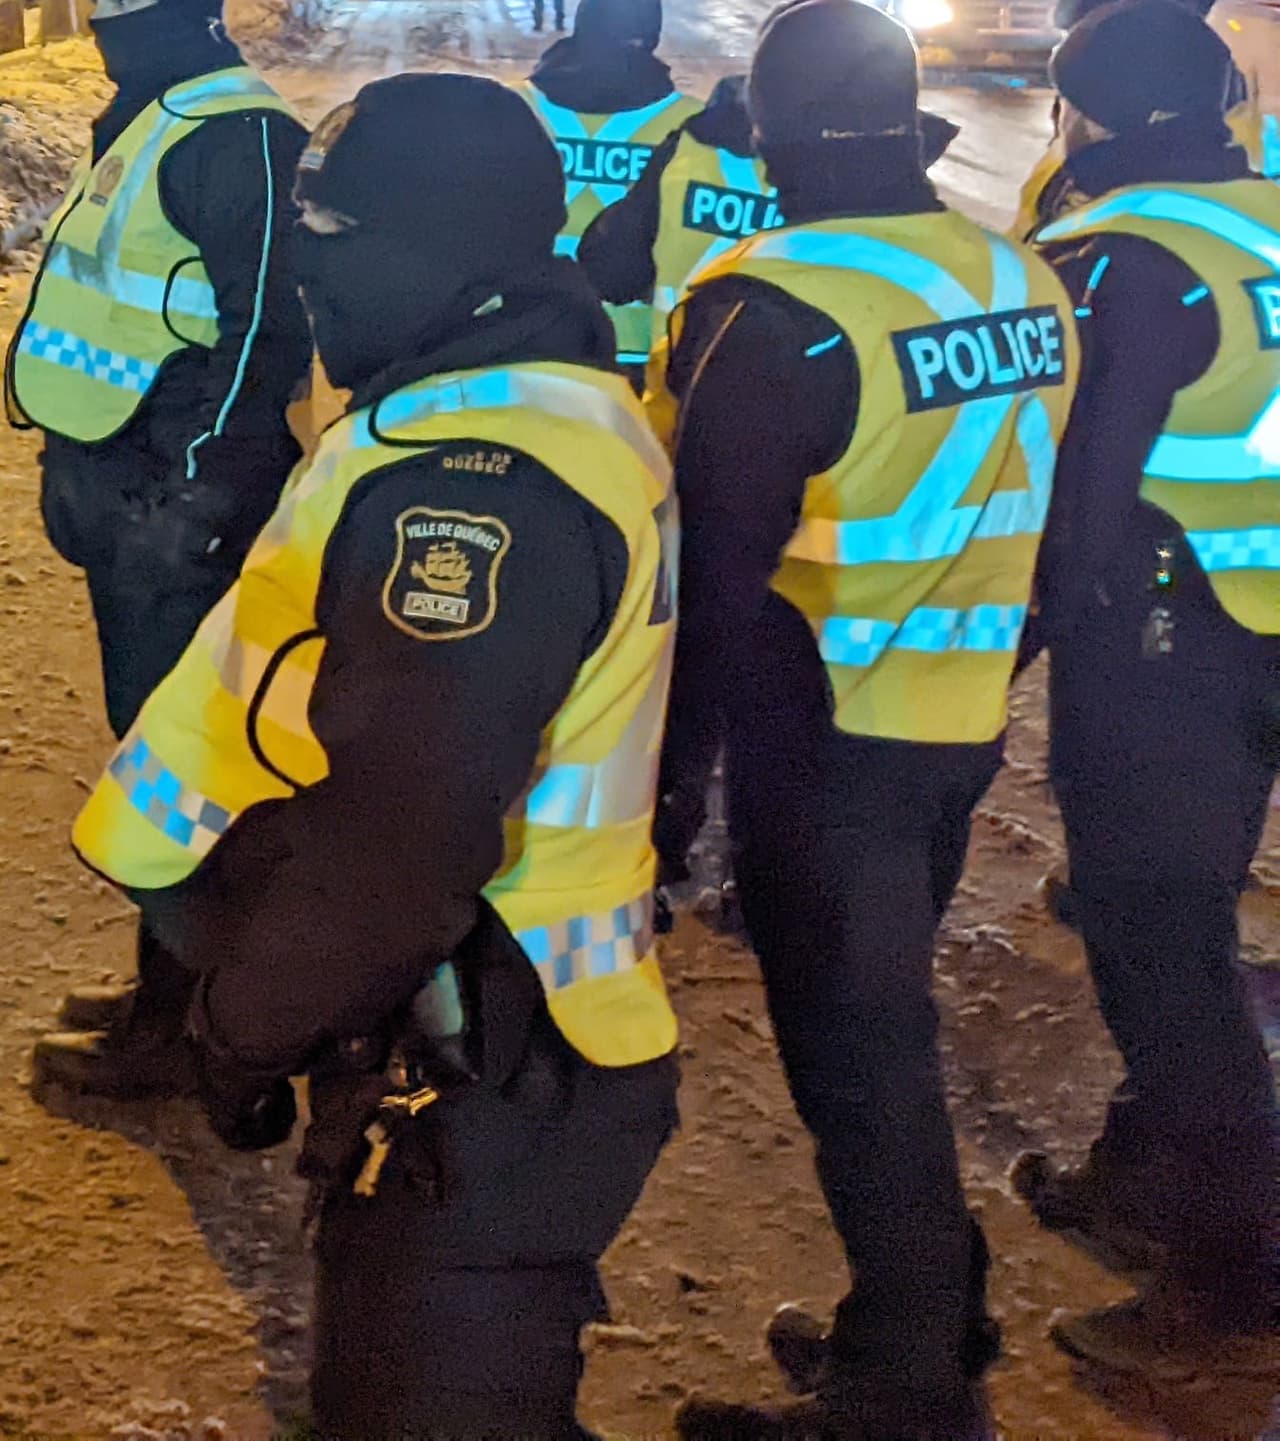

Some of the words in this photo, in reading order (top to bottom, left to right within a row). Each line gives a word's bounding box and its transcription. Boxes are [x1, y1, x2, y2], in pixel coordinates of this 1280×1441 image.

[556, 142, 652, 182] OLICE
[692, 186, 785, 236] POLI
[907, 316, 1063, 399] POLICE
[406, 522, 436, 539] VILLE
[437, 523, 453, 537] DE
[453, 524, 501, 552] QUÉBEC
[411, 596, 462, 618] POLICE
